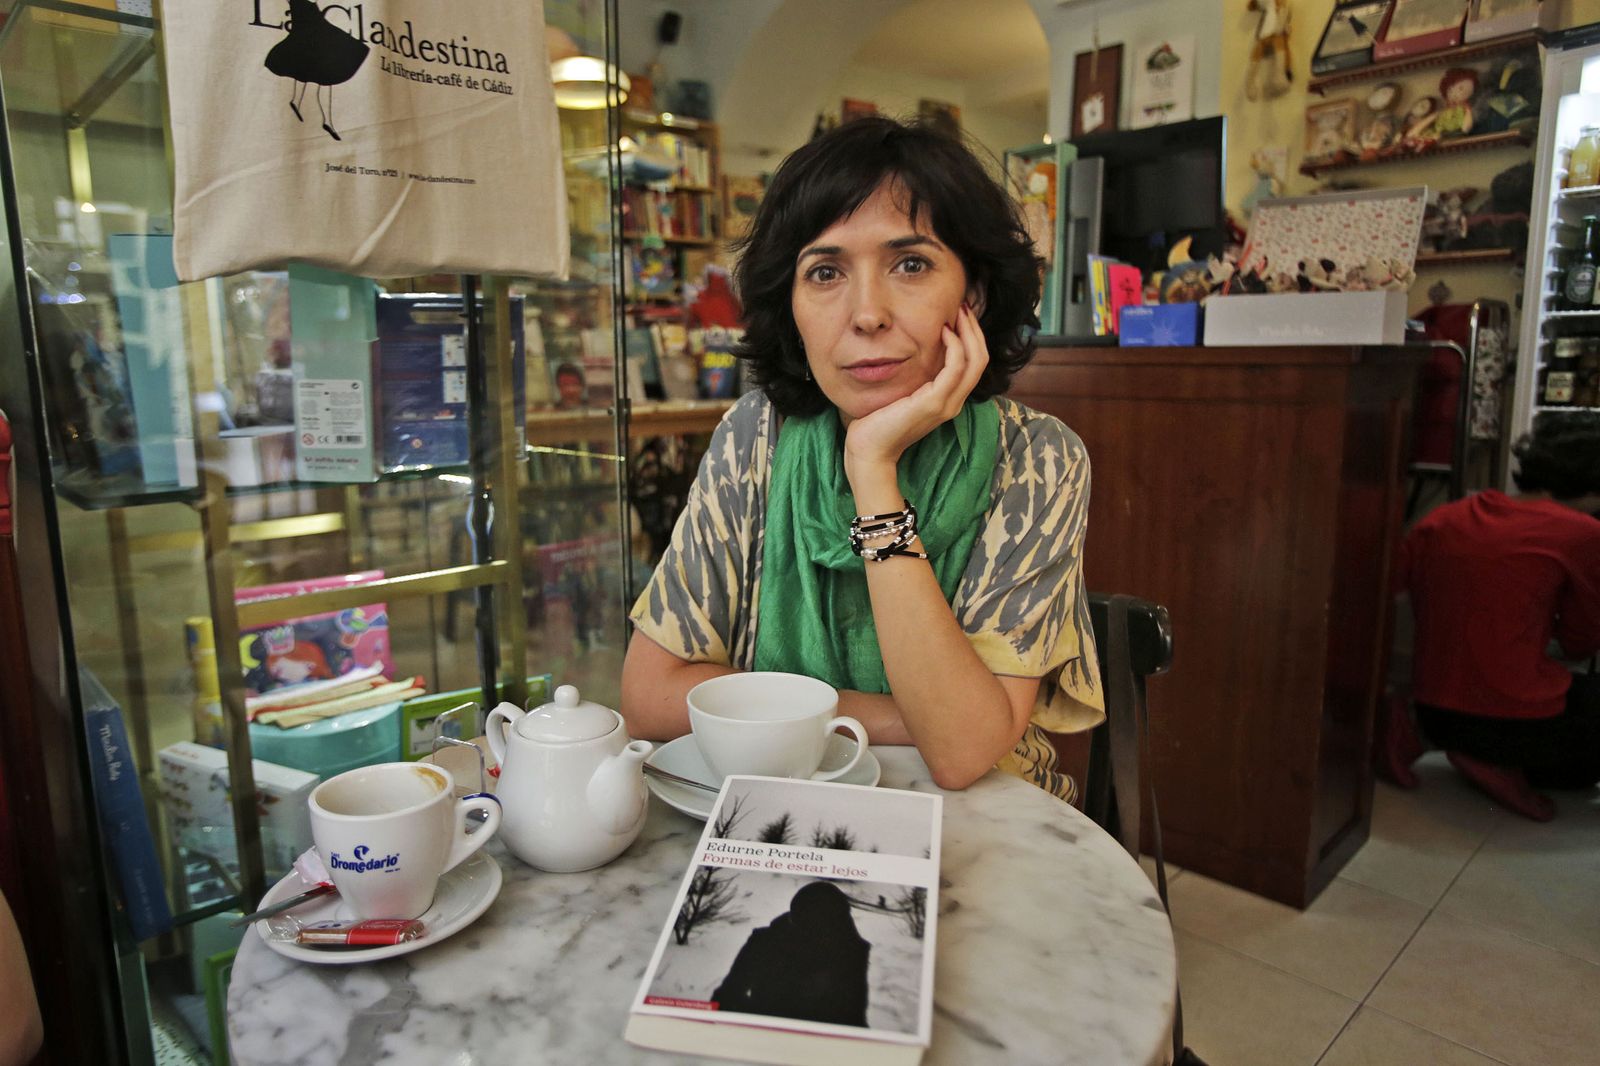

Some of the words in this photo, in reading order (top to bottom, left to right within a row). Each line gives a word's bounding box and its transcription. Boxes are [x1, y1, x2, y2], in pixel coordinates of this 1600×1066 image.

[321, 4, 510, 74] Clandestina
[381, 56, 391, 73] La
[466, 76, 479, 90] de
[482, 79, 514, 96] Cádiz
[325, 163, 343, 172] José
[345, 165, 357, 174] del
[706, 842, 764, 857] Edurne
[768, 847, 824, 862] Portela
[331, 855, 398, 873] Dromedario
[702, 853, 761, 867] Formas
[765, 859, 783, 870] de
[787, 861, 828, 874] estar
[831, 865, 868, 878] lejos
